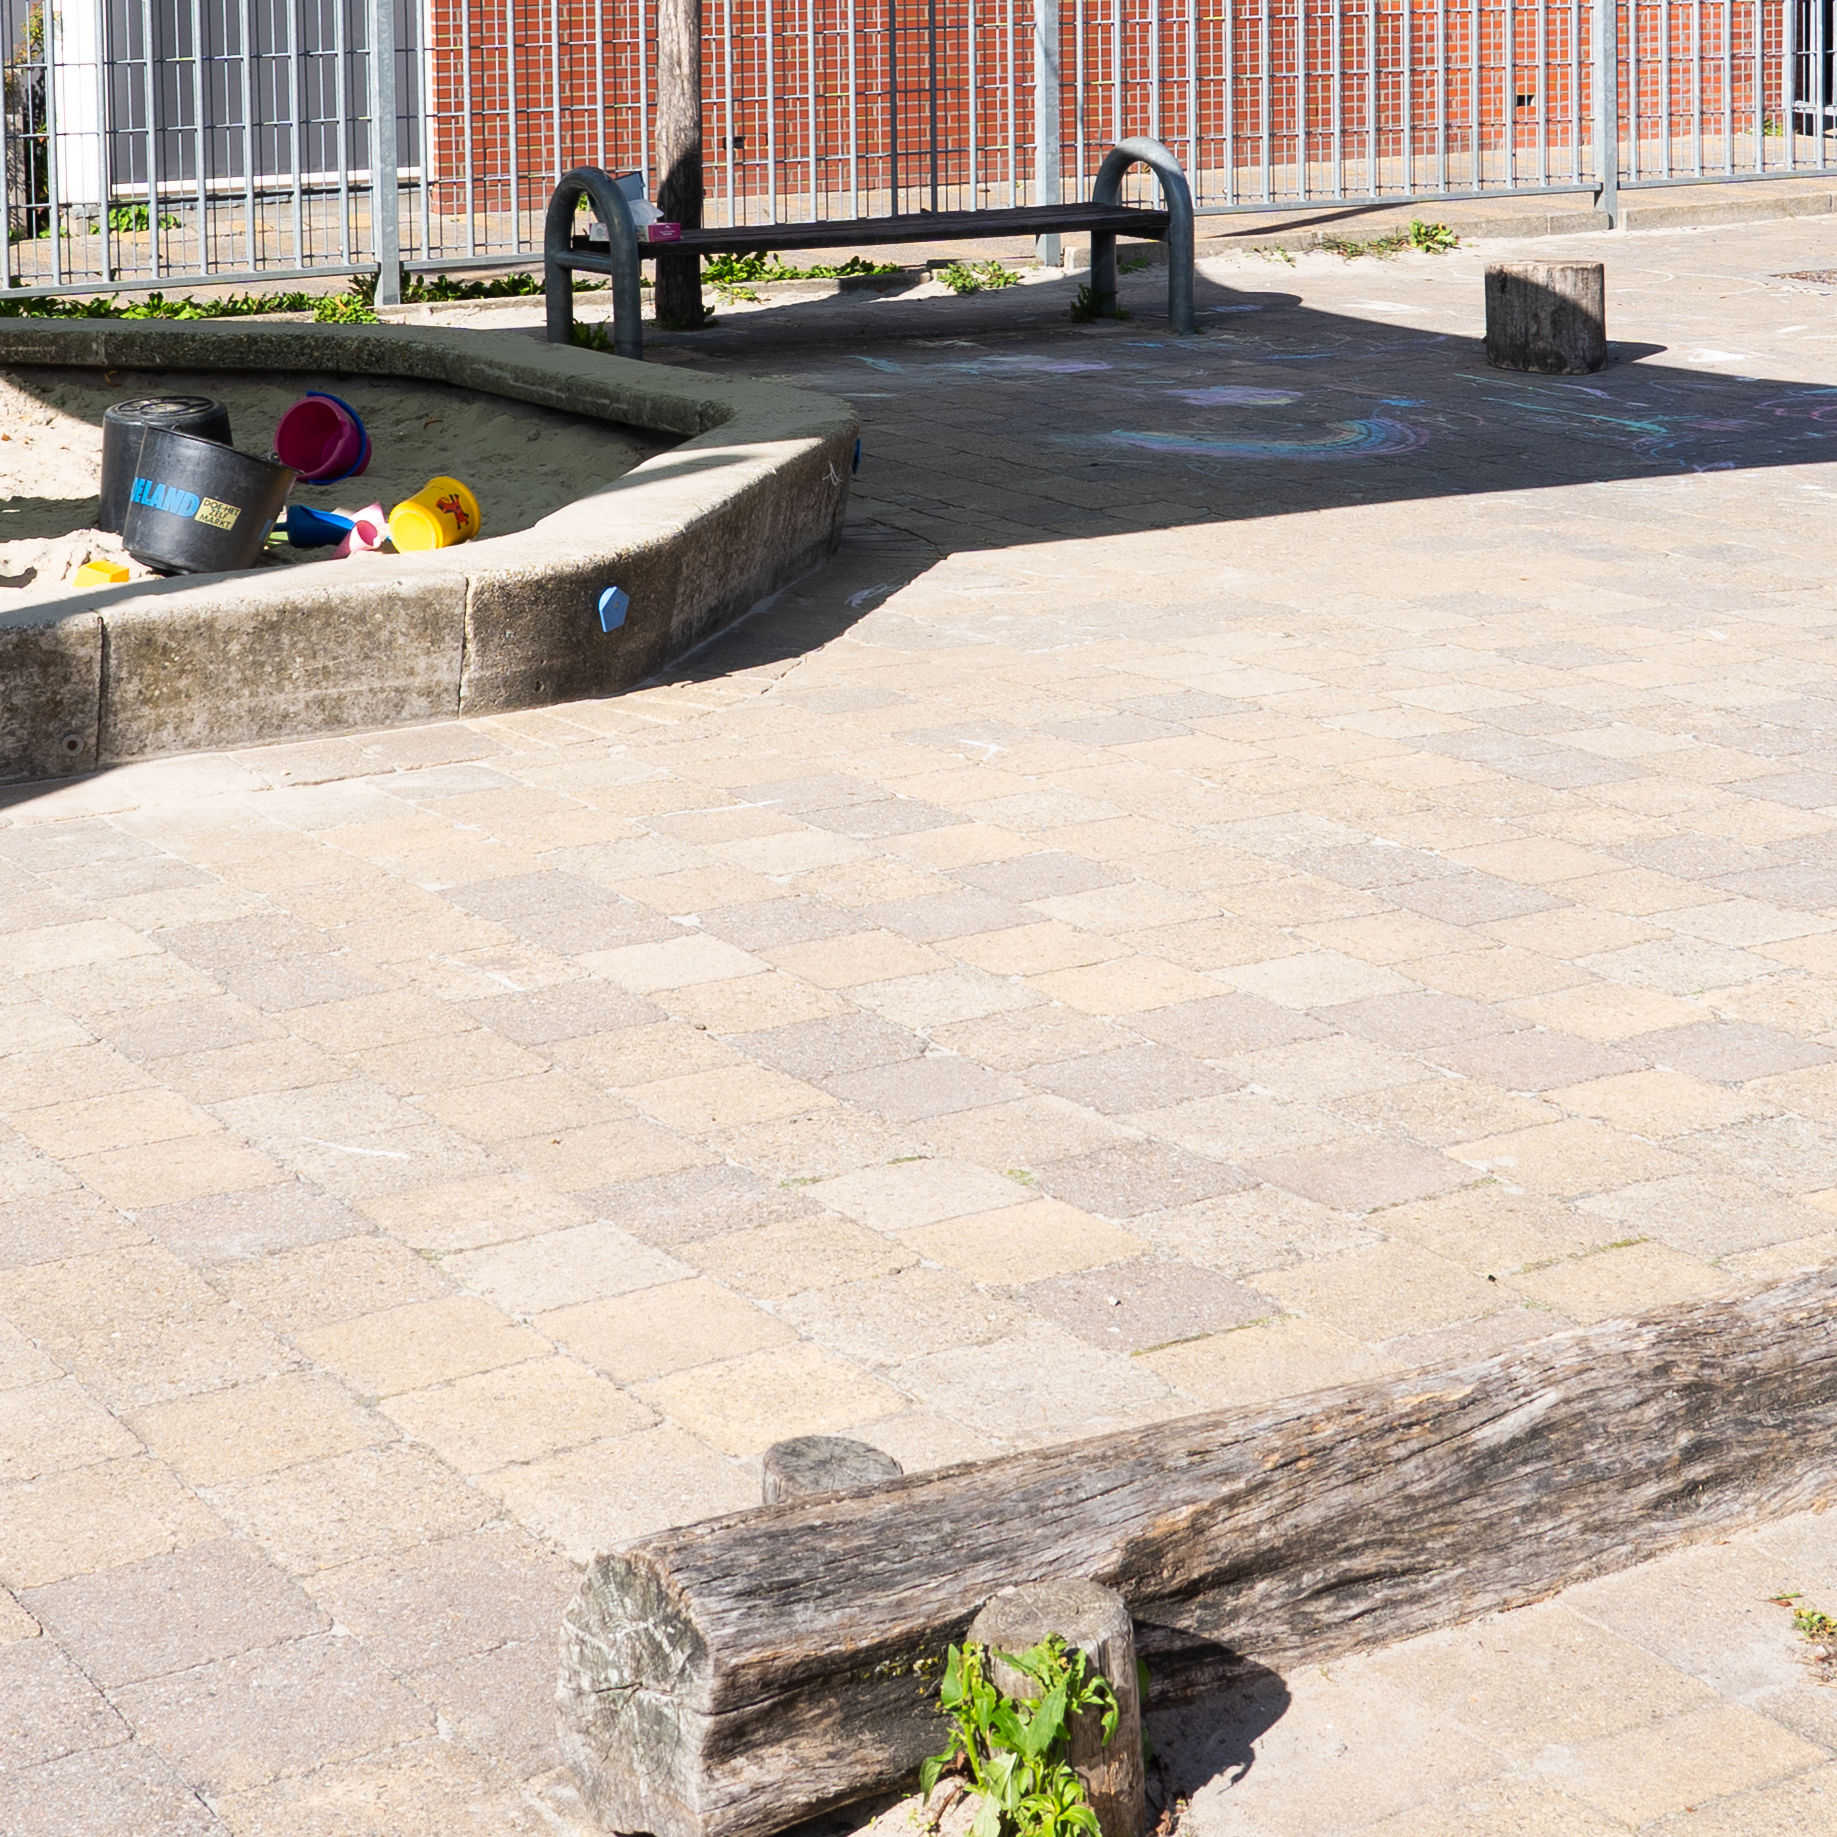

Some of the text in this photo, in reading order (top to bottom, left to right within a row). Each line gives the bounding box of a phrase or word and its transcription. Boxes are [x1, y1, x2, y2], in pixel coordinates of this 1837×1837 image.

[130, 477, 200, 517] ELAND
[199, 514, 231, 528] MARKT
[209, 508, 229, 520] ZELF
